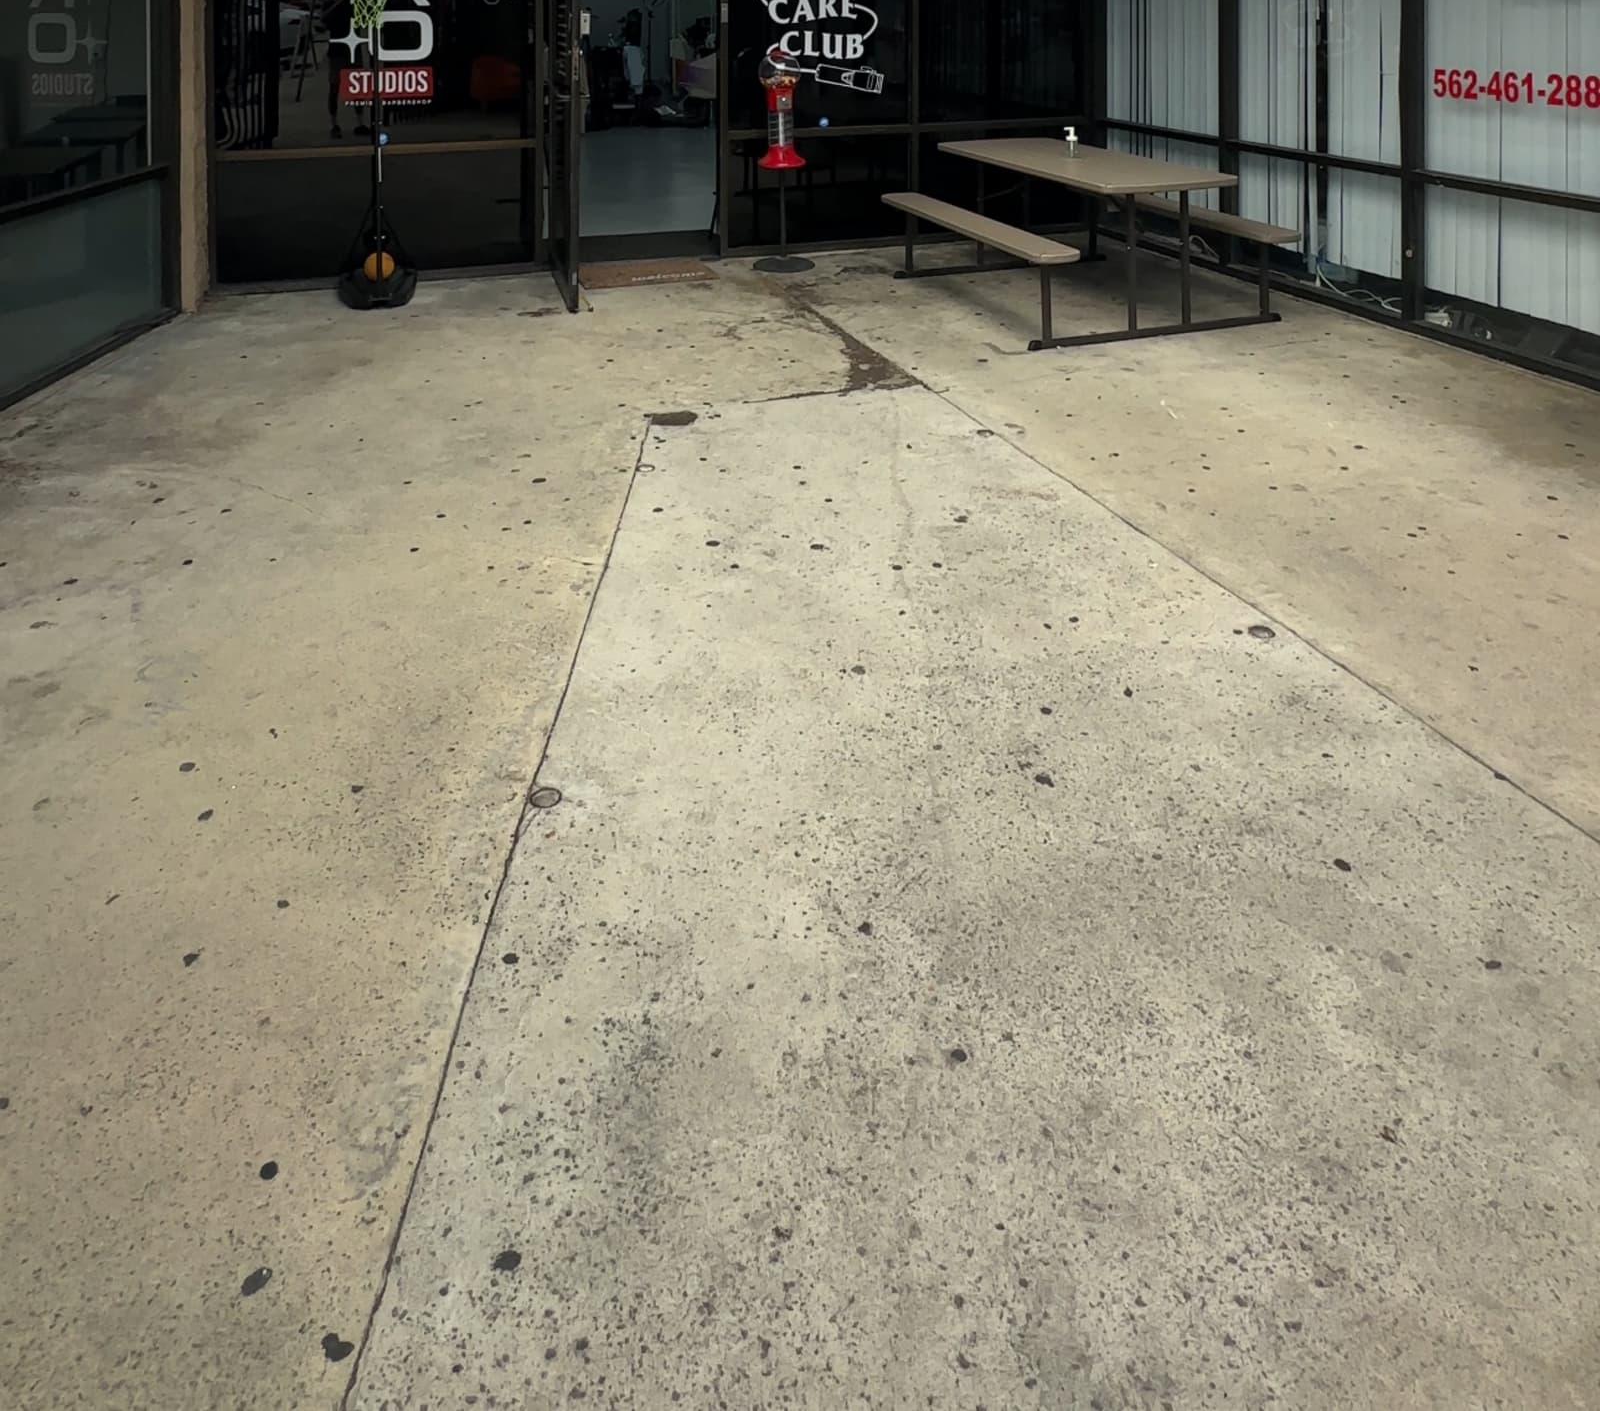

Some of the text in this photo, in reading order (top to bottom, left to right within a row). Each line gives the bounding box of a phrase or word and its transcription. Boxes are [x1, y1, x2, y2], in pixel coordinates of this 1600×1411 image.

[780, 30, 864, 59] CLUB
[349, 70, 429, 93] STUDIOS
[1433, 69, 1600, 108] 562-461-288
